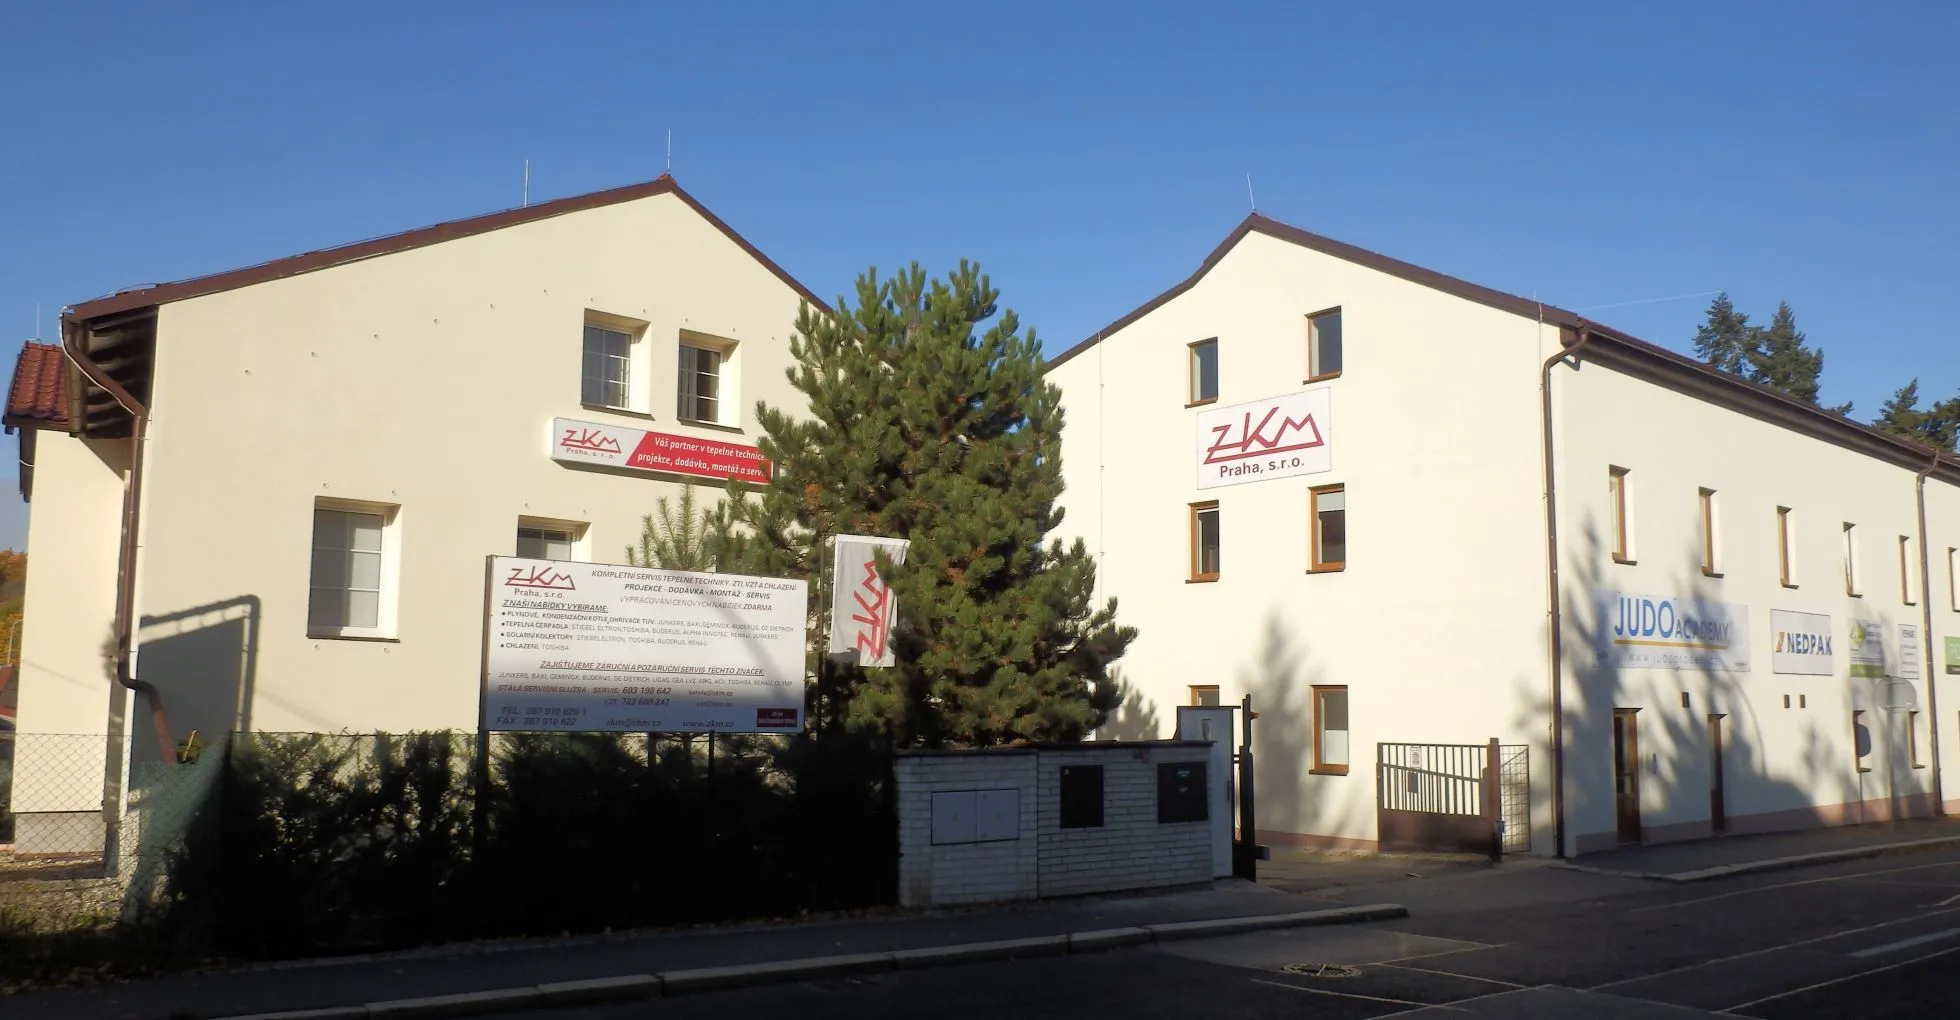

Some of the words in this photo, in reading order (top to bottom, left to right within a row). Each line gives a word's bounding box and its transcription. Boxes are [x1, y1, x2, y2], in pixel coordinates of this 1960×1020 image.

[654, 436, 669, 448] Váš
[669, 441, 699, 453] partner
[706, 444, 735, 458] tepelné
[637, 452, 673, 467] projekce,
[674, 456, 710, 471] dodávka,
[711, 460, 739, 473] montáž
[1220, 462, 1264, 478] Praha,
[1268, 457, 1305, 471] s.r.o.
[635, 572, 661, 580] SERVIS
[514, 588, 542, 599] Praha,
[624, 582, 662, 591] PROJEKCE
[746, 591, 770, 599] SERVIS
[743, 602, 771, 611] ZDARMA
[1614, 597, 1674, 638] JUDO
[1674, 617, 1730, 642] ACADEMY
[1786, 632, 1832, 655] NEDPAK
[640, 686, 654, 694] 198
